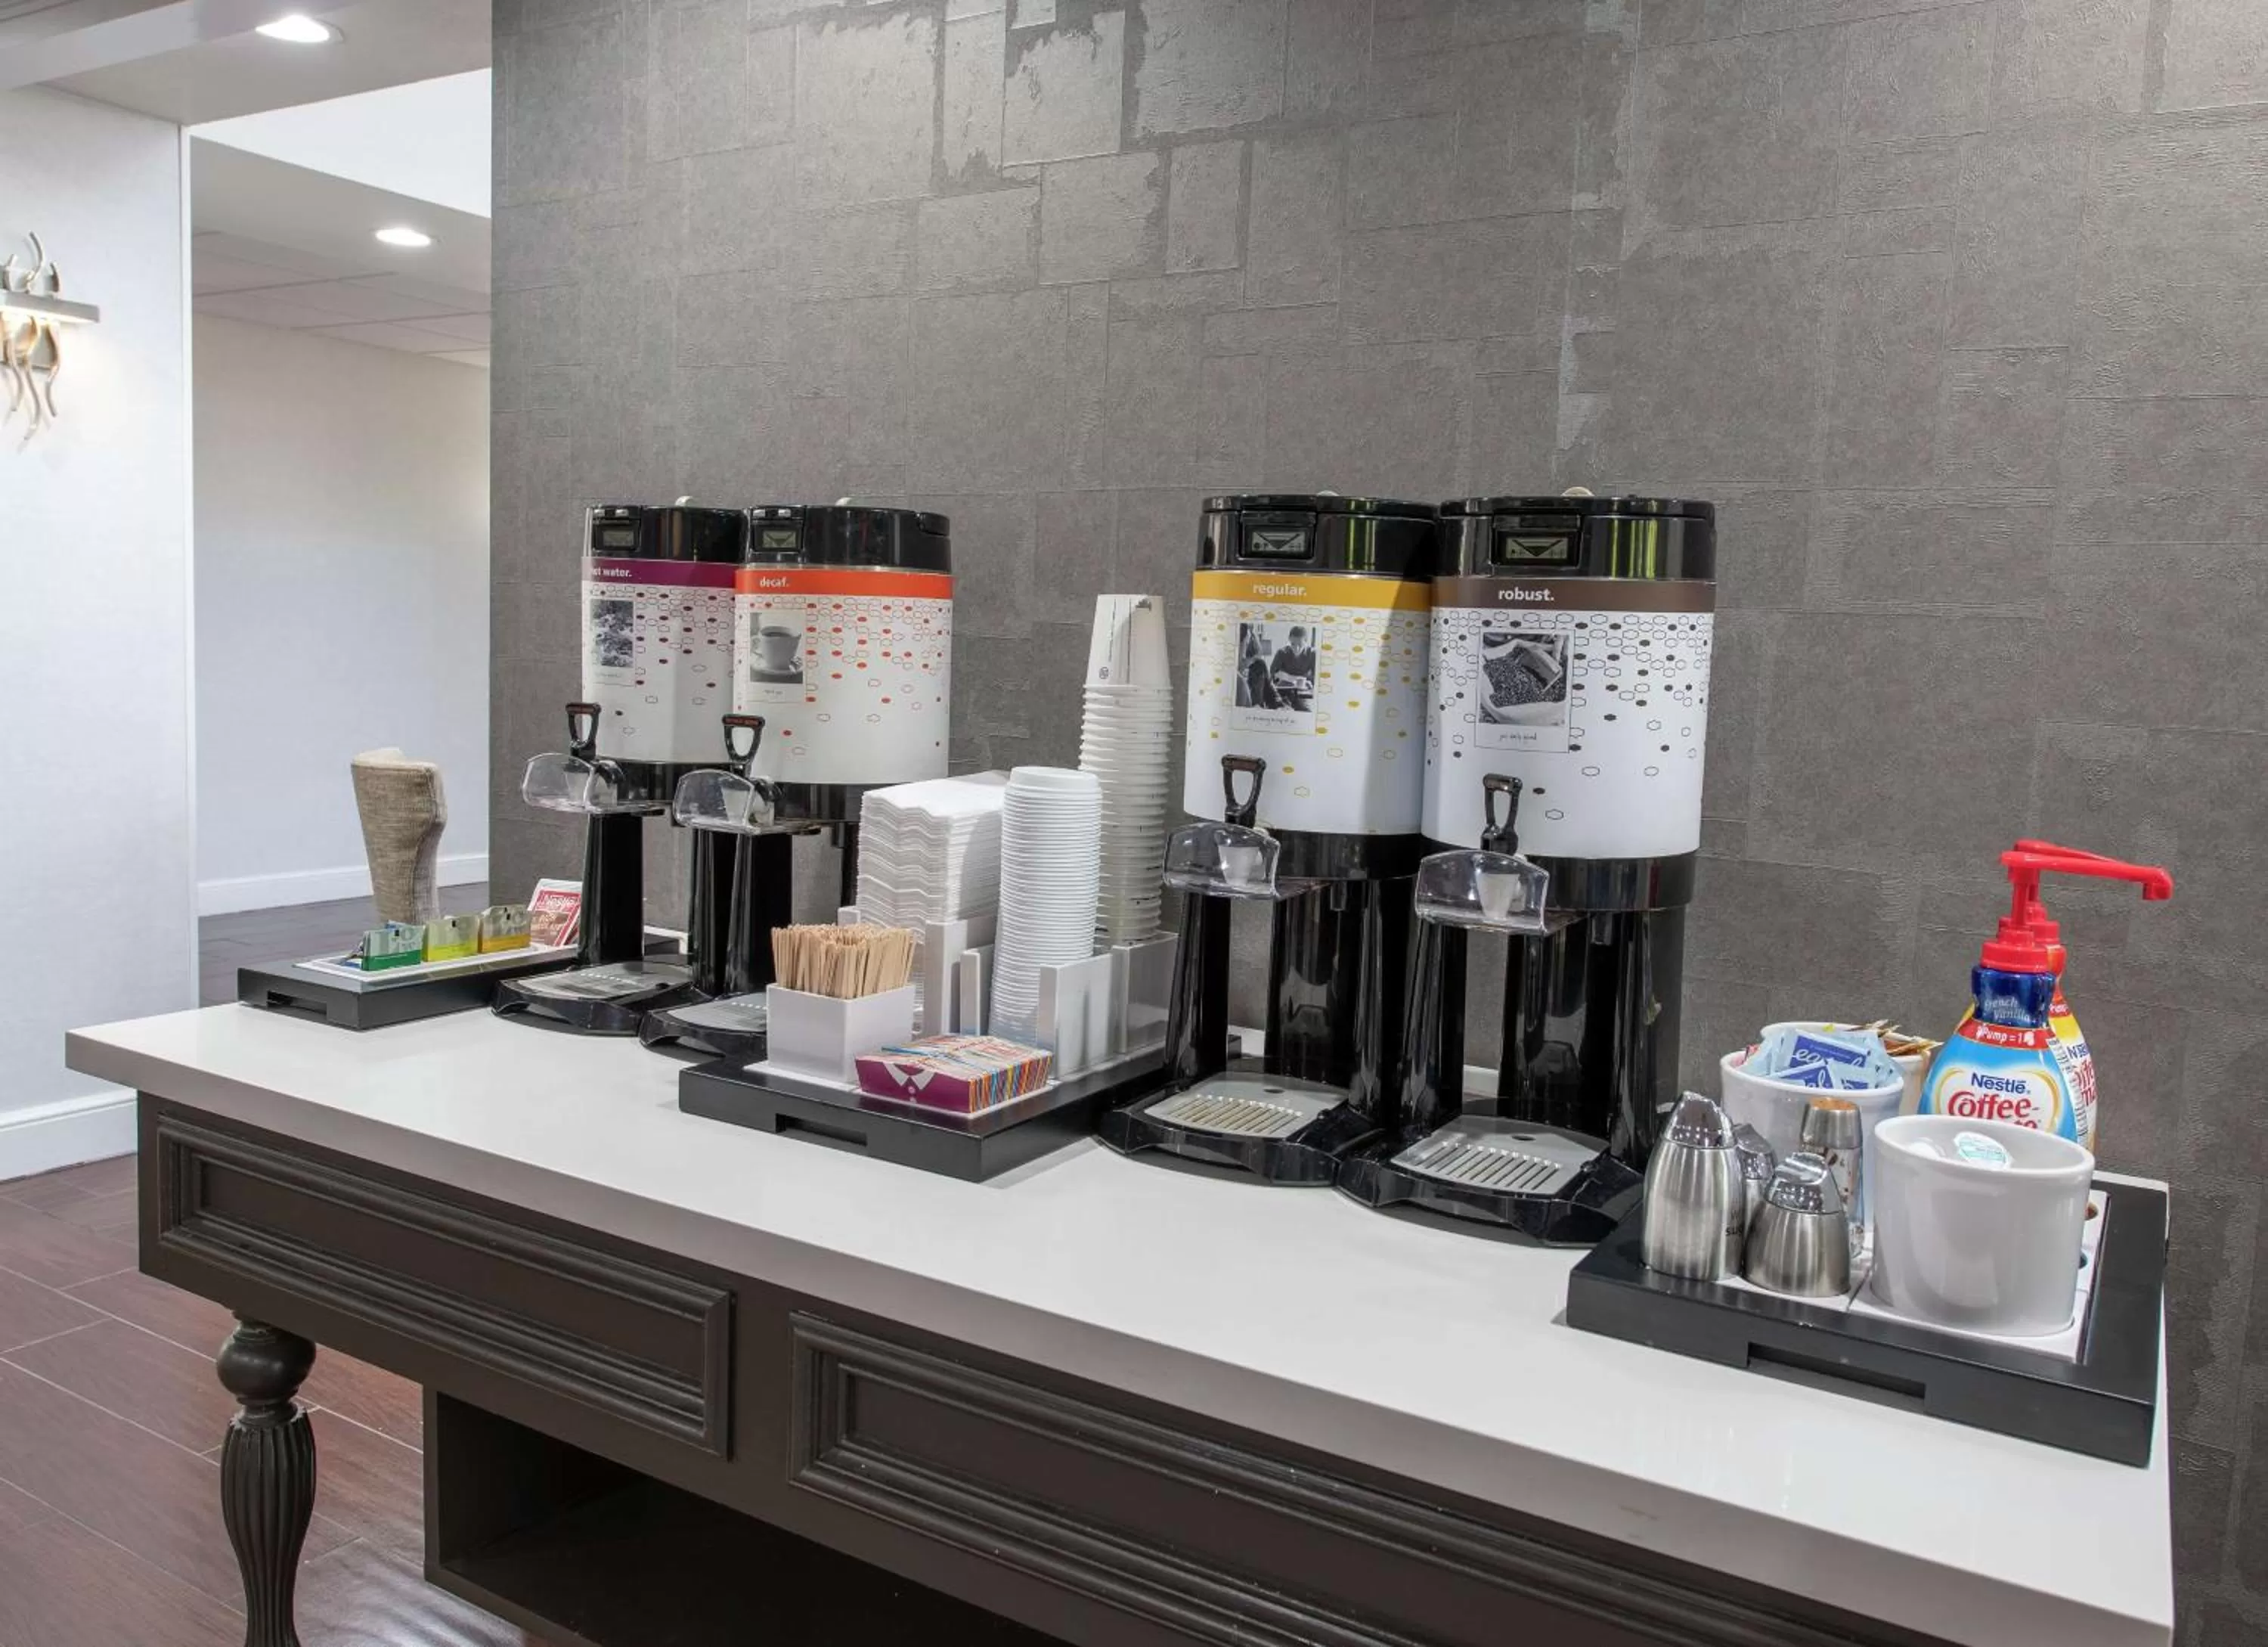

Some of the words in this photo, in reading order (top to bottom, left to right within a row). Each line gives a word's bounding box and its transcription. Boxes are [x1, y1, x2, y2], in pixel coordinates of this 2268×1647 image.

[603, 567, 633, 577] water.
[760, 575, 789, 588] decaf.
[1253, 583, 1307, 597] regular.
[1498, 587, 1554, 601] robust.
